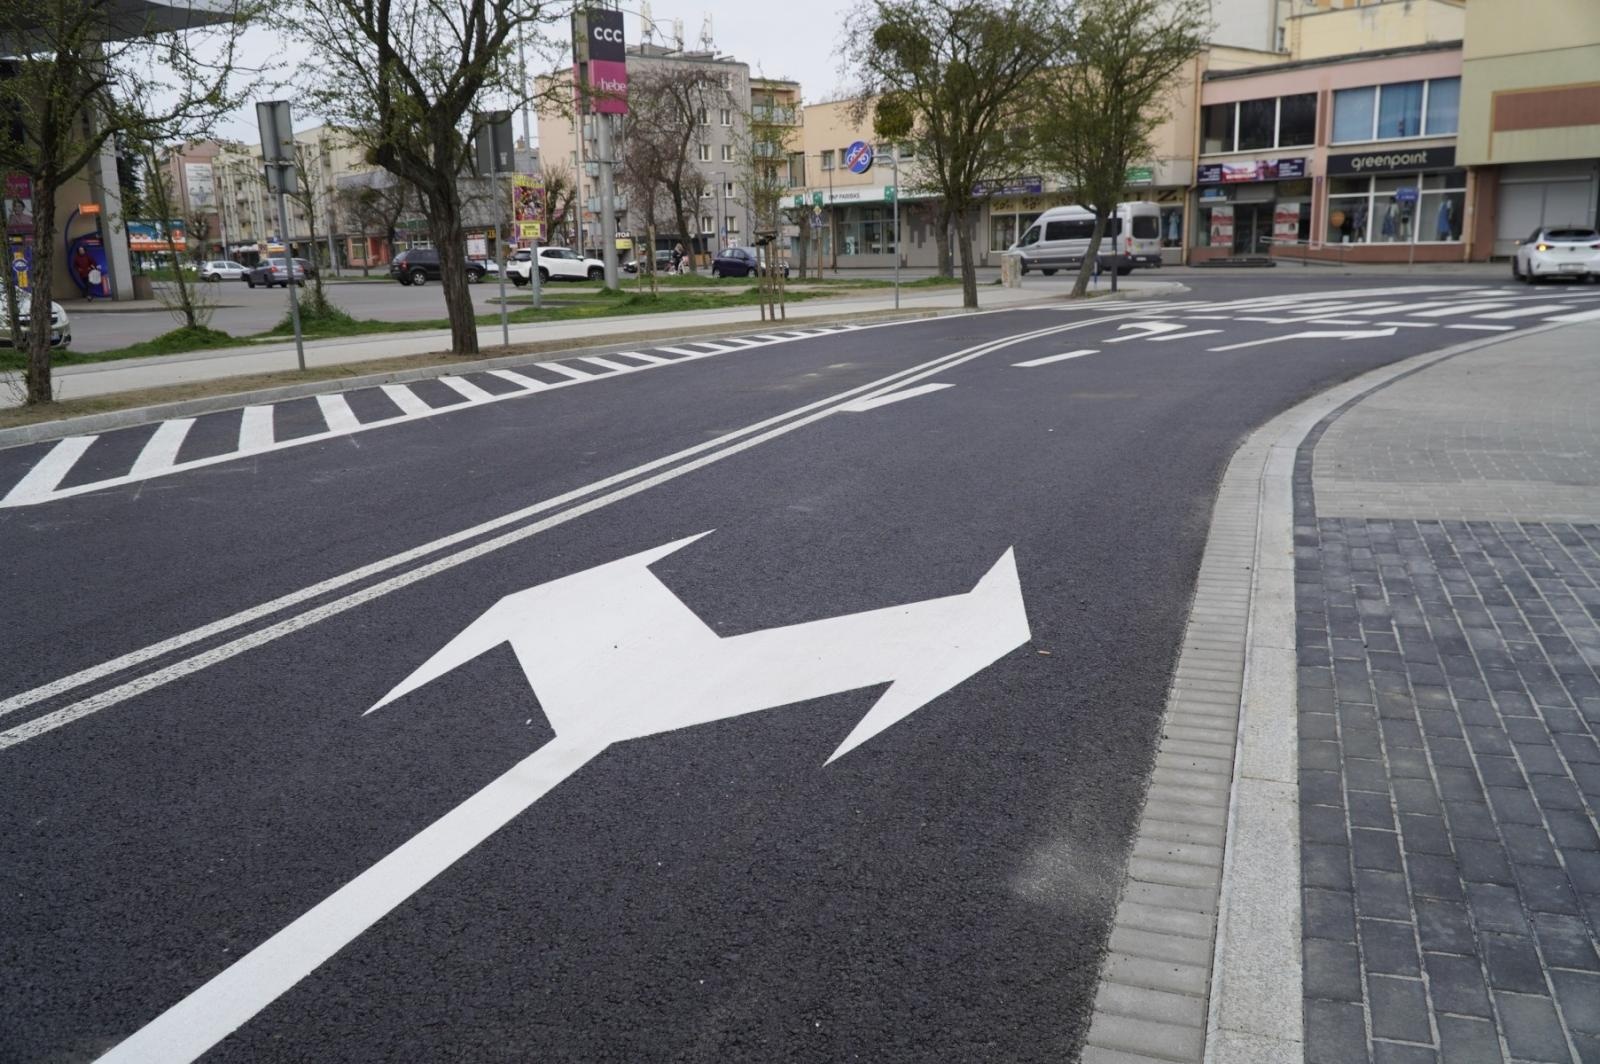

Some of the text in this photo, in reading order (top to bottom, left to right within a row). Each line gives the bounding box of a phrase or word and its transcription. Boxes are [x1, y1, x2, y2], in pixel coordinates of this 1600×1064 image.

[593, 27, 623, 43] CCC
[601, 77, 627, 91] hebe
[1350, 150, 1428, 172] greenpoint
